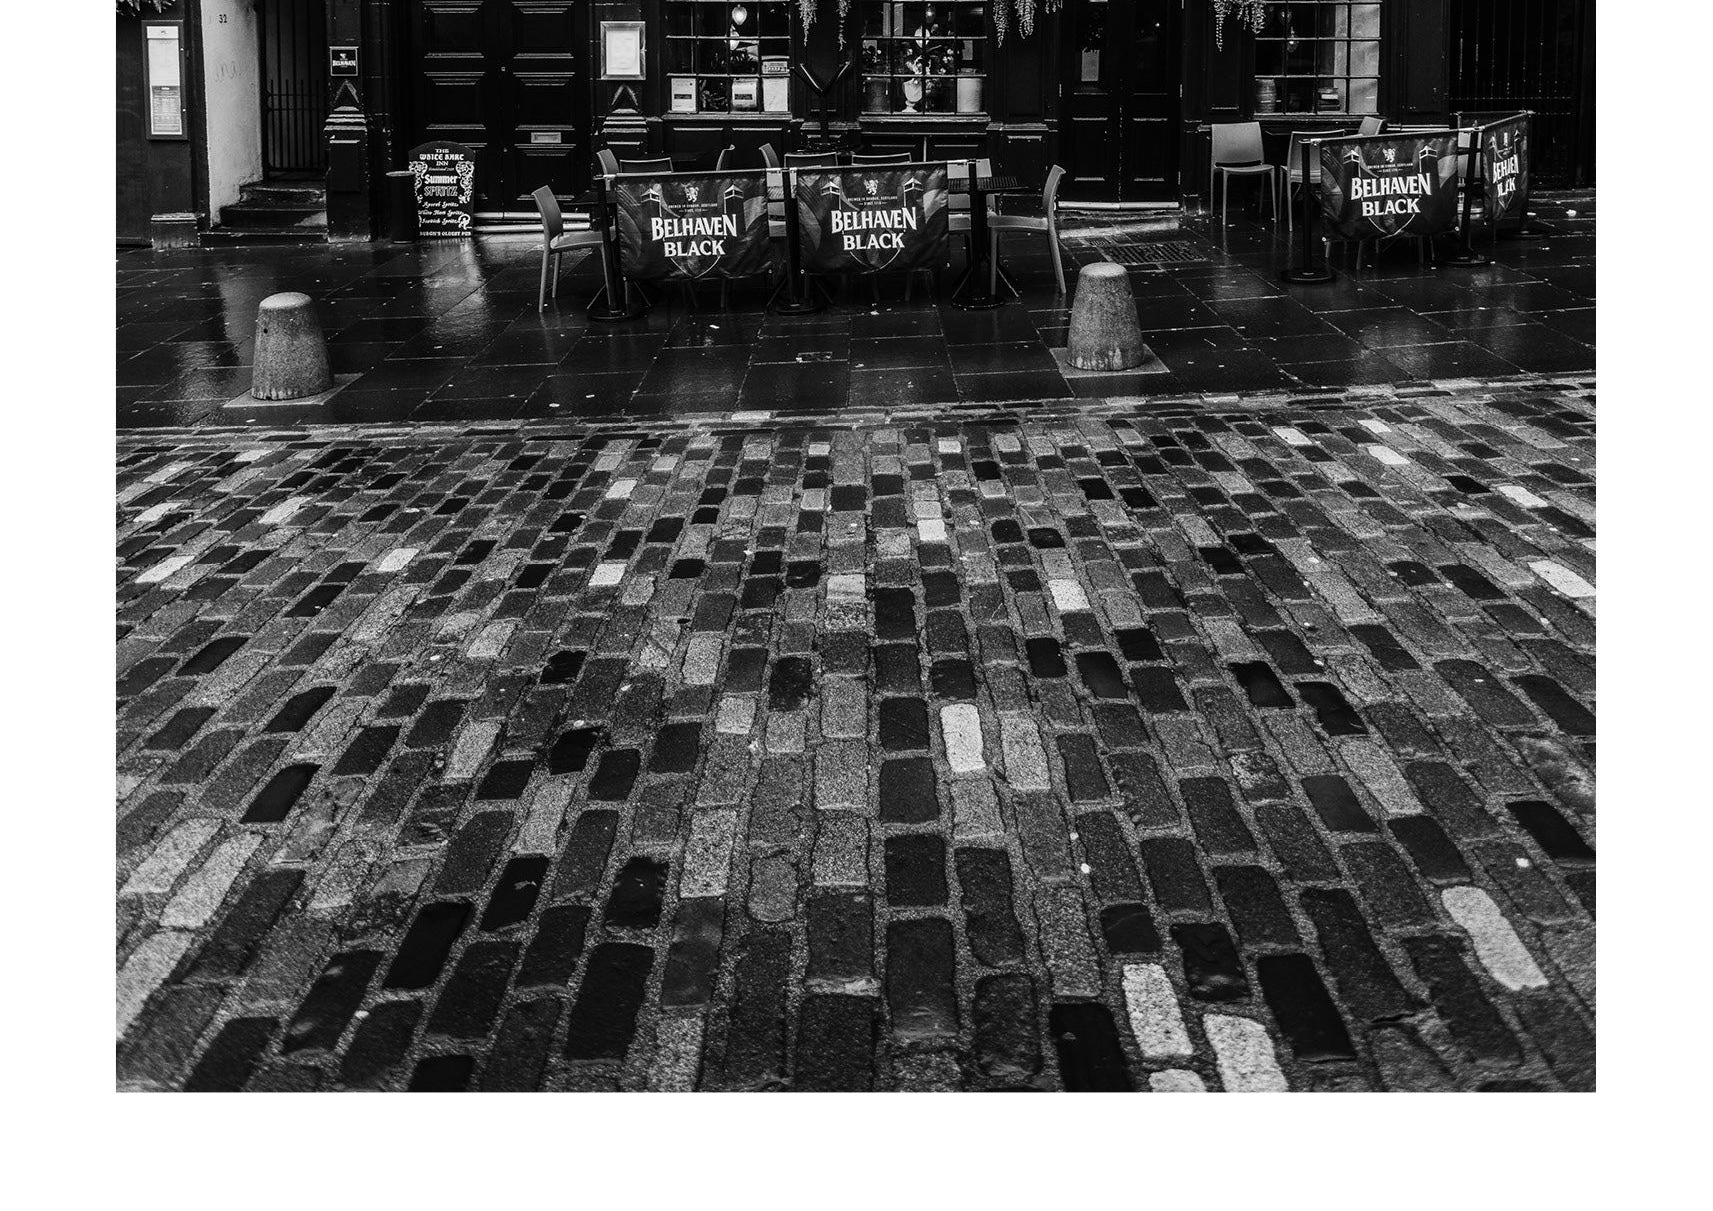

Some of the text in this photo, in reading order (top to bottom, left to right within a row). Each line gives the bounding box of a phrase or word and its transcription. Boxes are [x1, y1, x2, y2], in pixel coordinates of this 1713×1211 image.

[424, 174, 459, 184] Summer
[1350, 172, 1432, 201] BELHAVEN
[1362, 197, 1421, 217] BLACK
[651, 213, 737, 241] BELHAVEN
[830, 206, 917, 234] BELHAVEN
[664, 239, 726, 257] BLACK
[843, 232, 905, 251] BLACK
